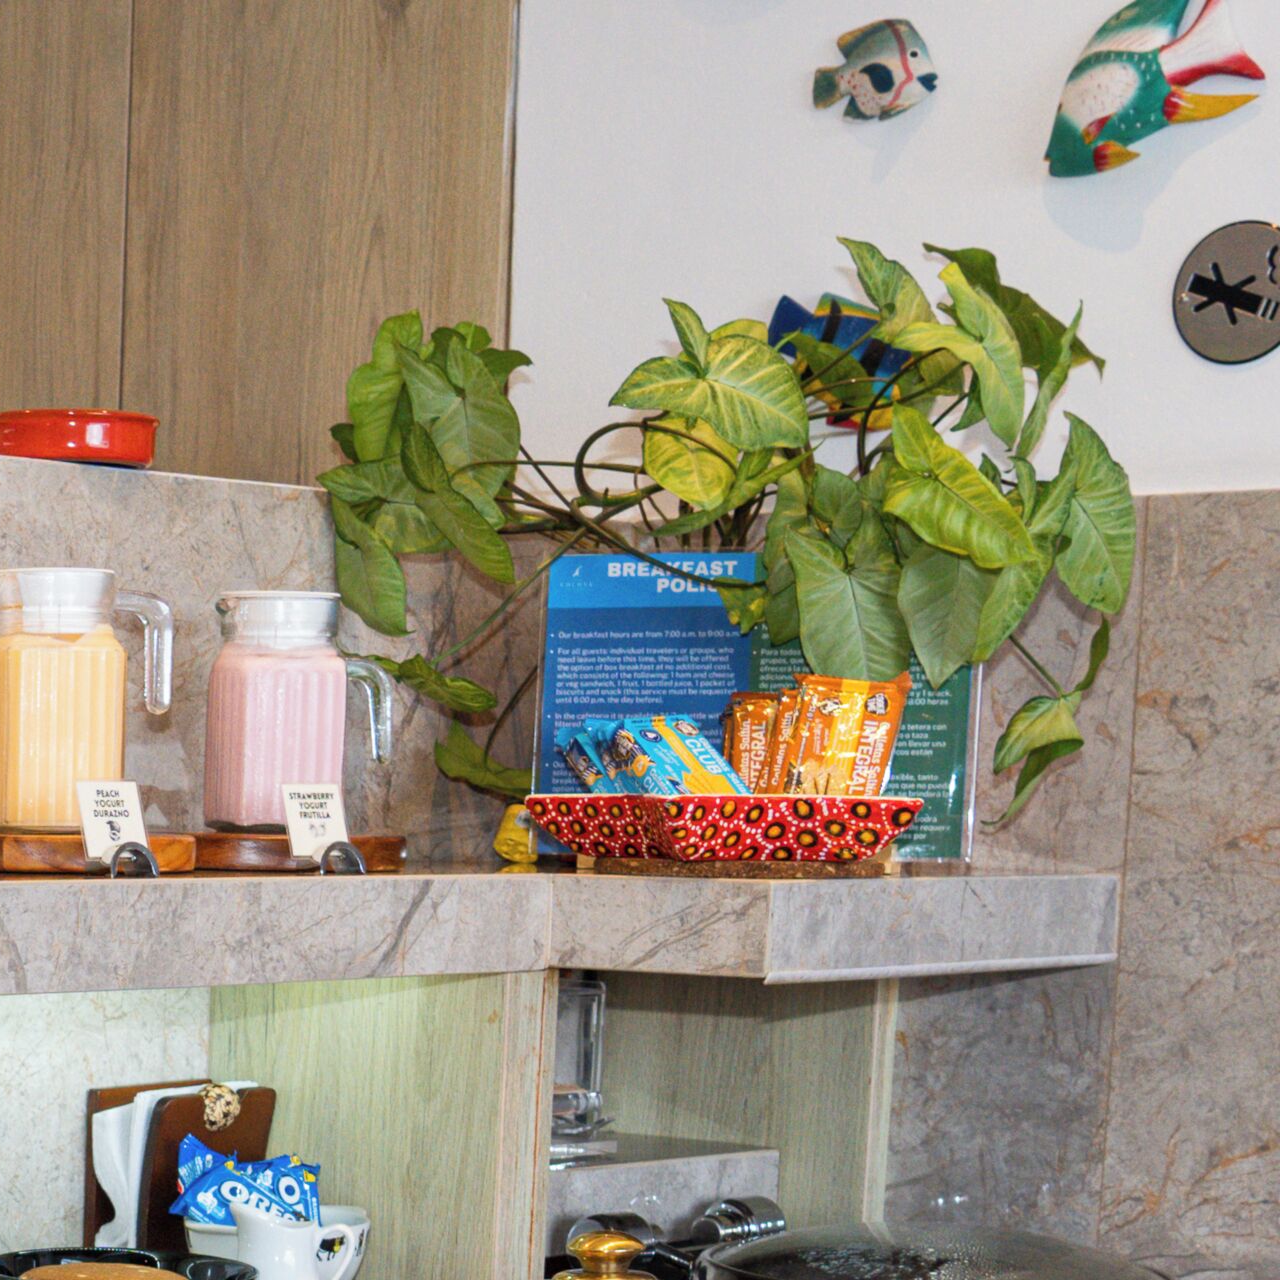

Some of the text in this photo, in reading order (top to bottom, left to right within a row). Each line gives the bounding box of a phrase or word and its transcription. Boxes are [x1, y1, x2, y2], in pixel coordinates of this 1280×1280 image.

[685, 738, 723, 774] CLUB
[848, 720, 880, 795] INTEGRAL
[96, 789, 120, 798] PEACH
[289, 792, 334, 800] STRAWBERRY
[94, 799, 124, 808] YOGURT
[93, 809, 129, 818] DURAZNO
[300, 811, 330, 819] FRUTILLA
